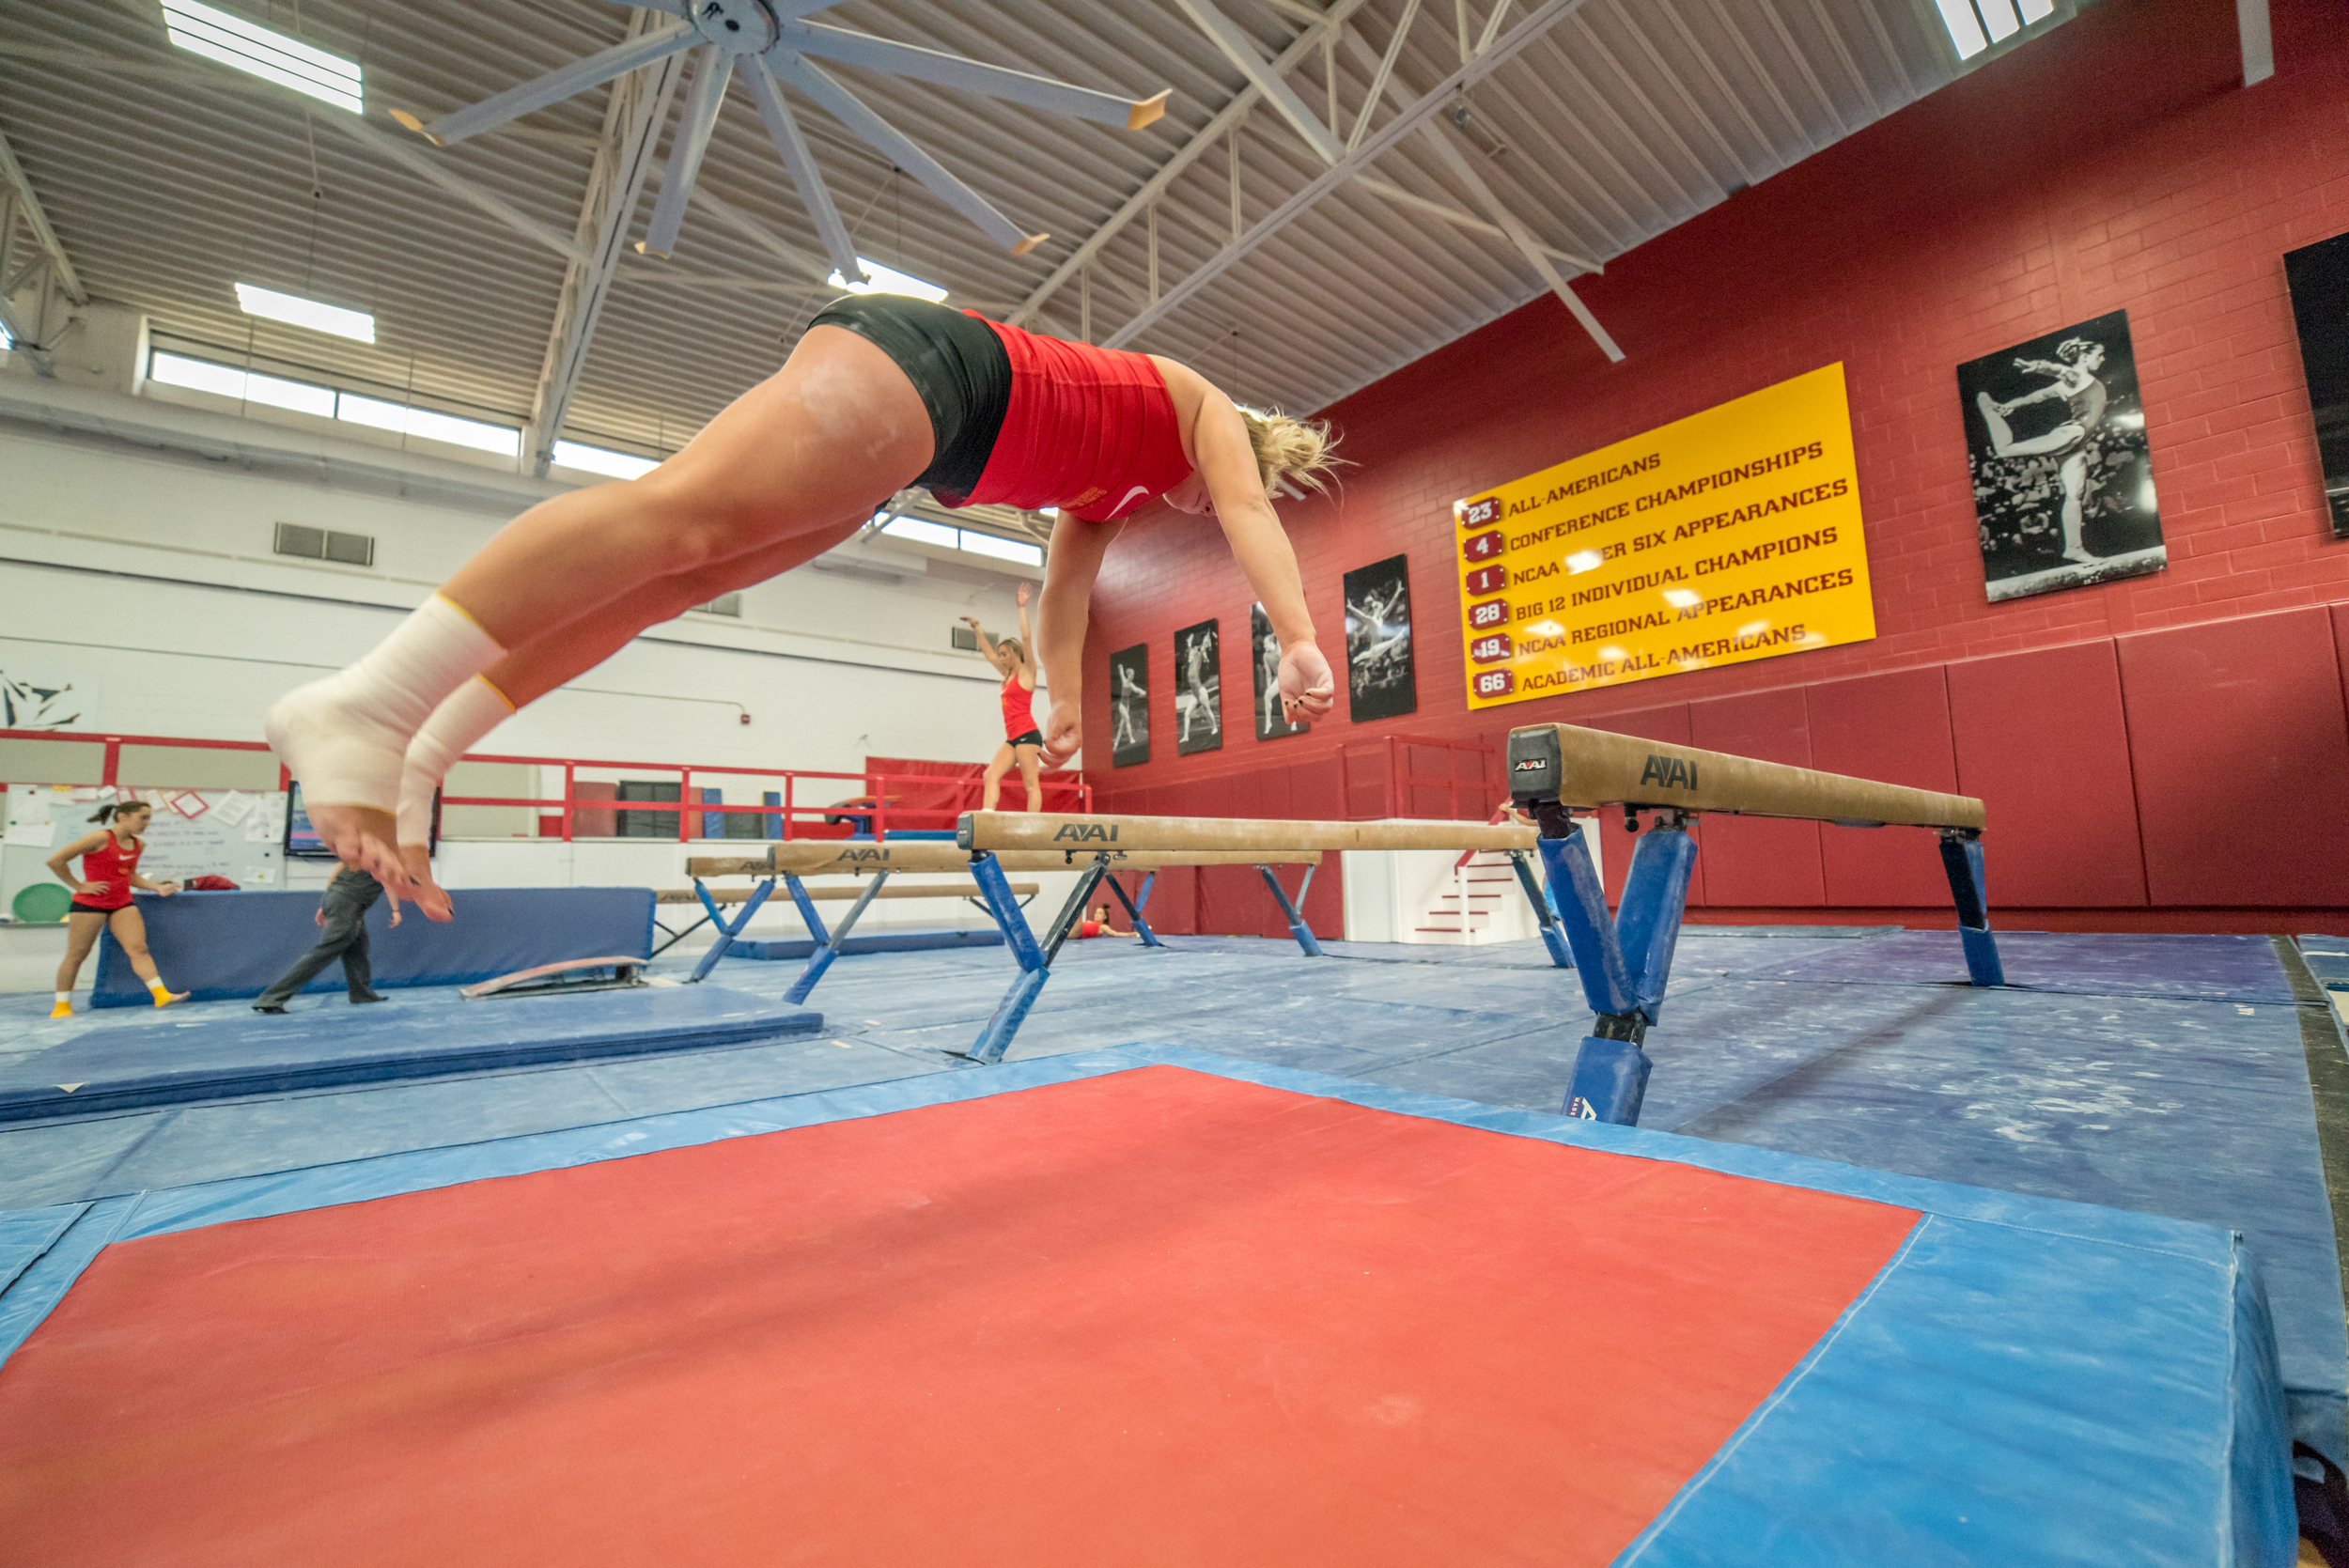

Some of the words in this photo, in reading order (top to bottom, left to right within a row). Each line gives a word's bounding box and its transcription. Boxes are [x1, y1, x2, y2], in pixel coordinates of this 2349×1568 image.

[1468, 502, 1492, 524] 23
[1508, 453, 1661, 517] ALL-AMERICANS
[1476, 537, 1489, 554] 4
[1510, 502, 1630, 551] CONFERENCE
[1636, 441, 1824, 512] CHAMPIONSHIPS
[1481, 571, 1489, 589] 1
[1514, 562, 1560, 585] NCAA
[1633, 530, 1667, 552] SIX
[1673, 478, 1848, 541] APPEARANCES
[1475, 603, 1501, 625] 28
[1516, 602, 1544, 621] BIG
[1549, 597, 1565, 613] 12
[1571, 566, 1688, 607] INDIVIDUAL
[1695, 526, 1838, 576] CHAMPIONS
[1480, 638, 1501, 658] 19
[1518, 634, 1566, 656] NCAA
[1571, 611, 1671, 644] REGIONAL
[1677, 568, 1854, 622] APPEARANCES
[1480, 673, 1505, 693] 66
[1522, 661, 1615, 691] ACADEMIC
[1621, 623, 1806, 674] ALL-AMERICANS
